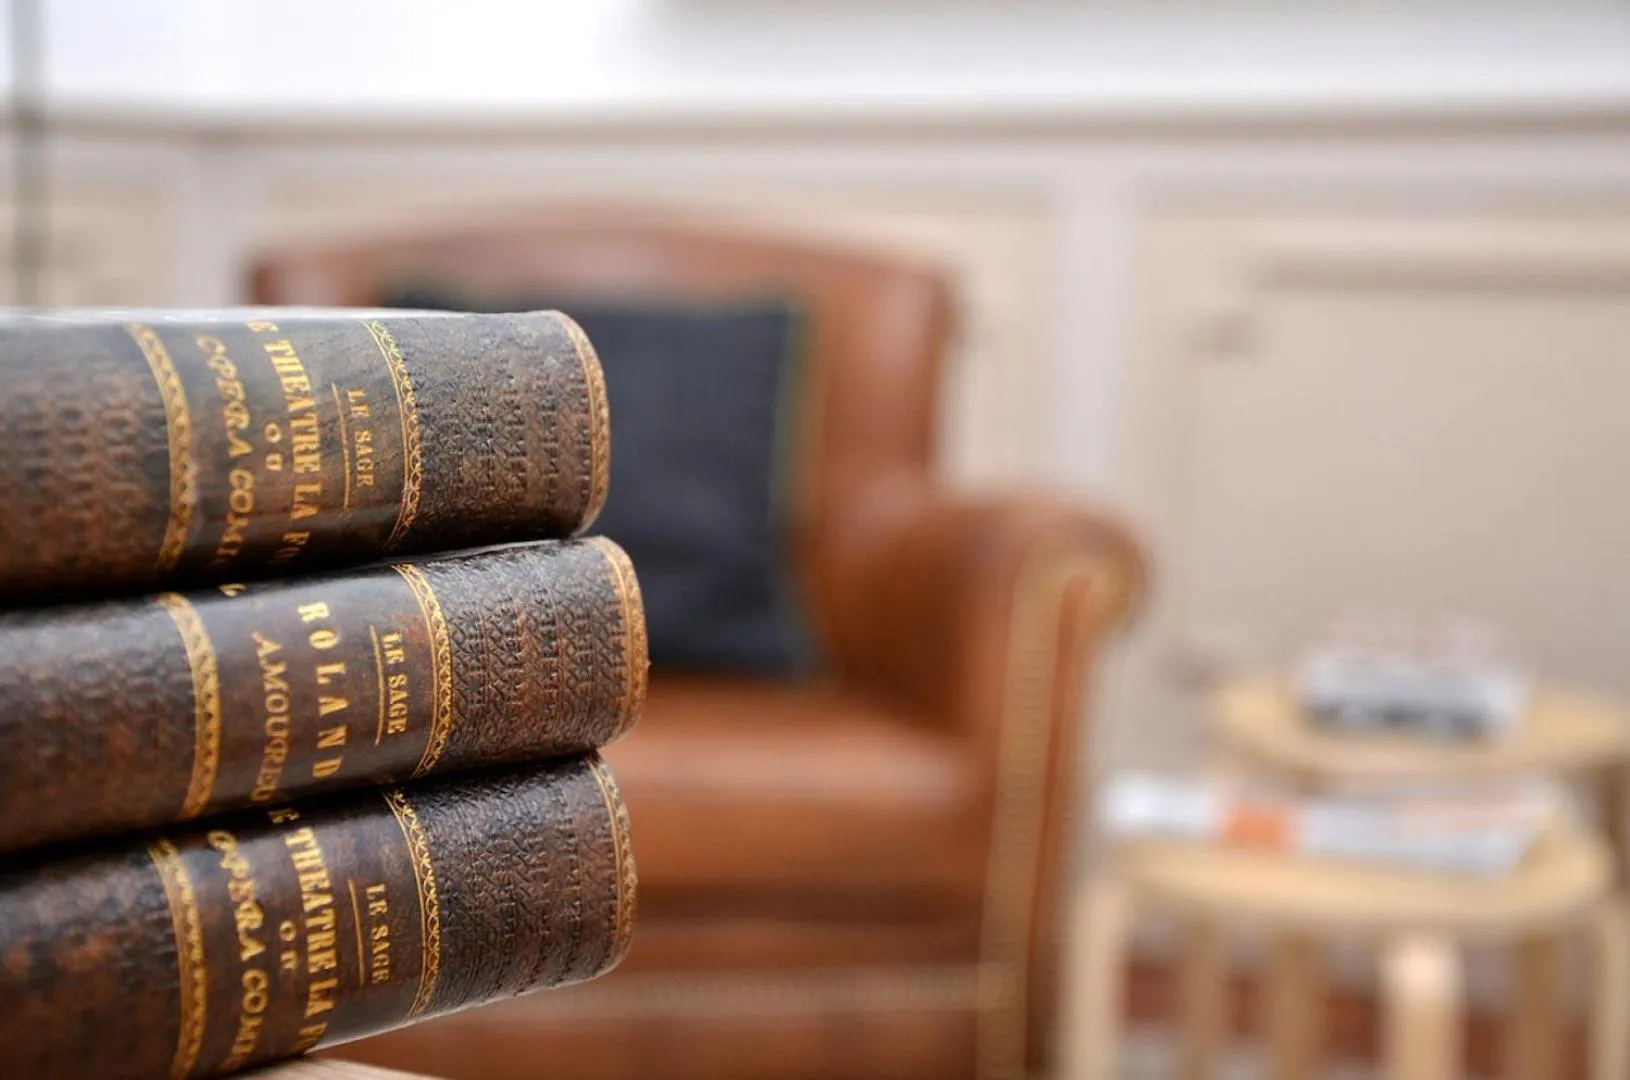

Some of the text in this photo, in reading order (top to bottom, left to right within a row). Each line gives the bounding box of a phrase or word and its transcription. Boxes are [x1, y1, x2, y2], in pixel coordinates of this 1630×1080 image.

[196, 335, 253, 458] OPERA
[263, 339, 321, 474] THEATRE
[264, 422, 283, 471] OU
[347, 390, 375, 487] LE SAGE
[213, 468, 255, 564] COMI
[290, 482, 322, 520] LA
[297, 601, 349, 778] ROLAND
[382, 631, 409, 735] LE SAGE
[206, 829, 269, 1070] OPERA COMI
[284, 827, 337, 975] THEATRE
[365, 883, 391, 985] LE SAGE
[304, 977, 338, 1018] LA
